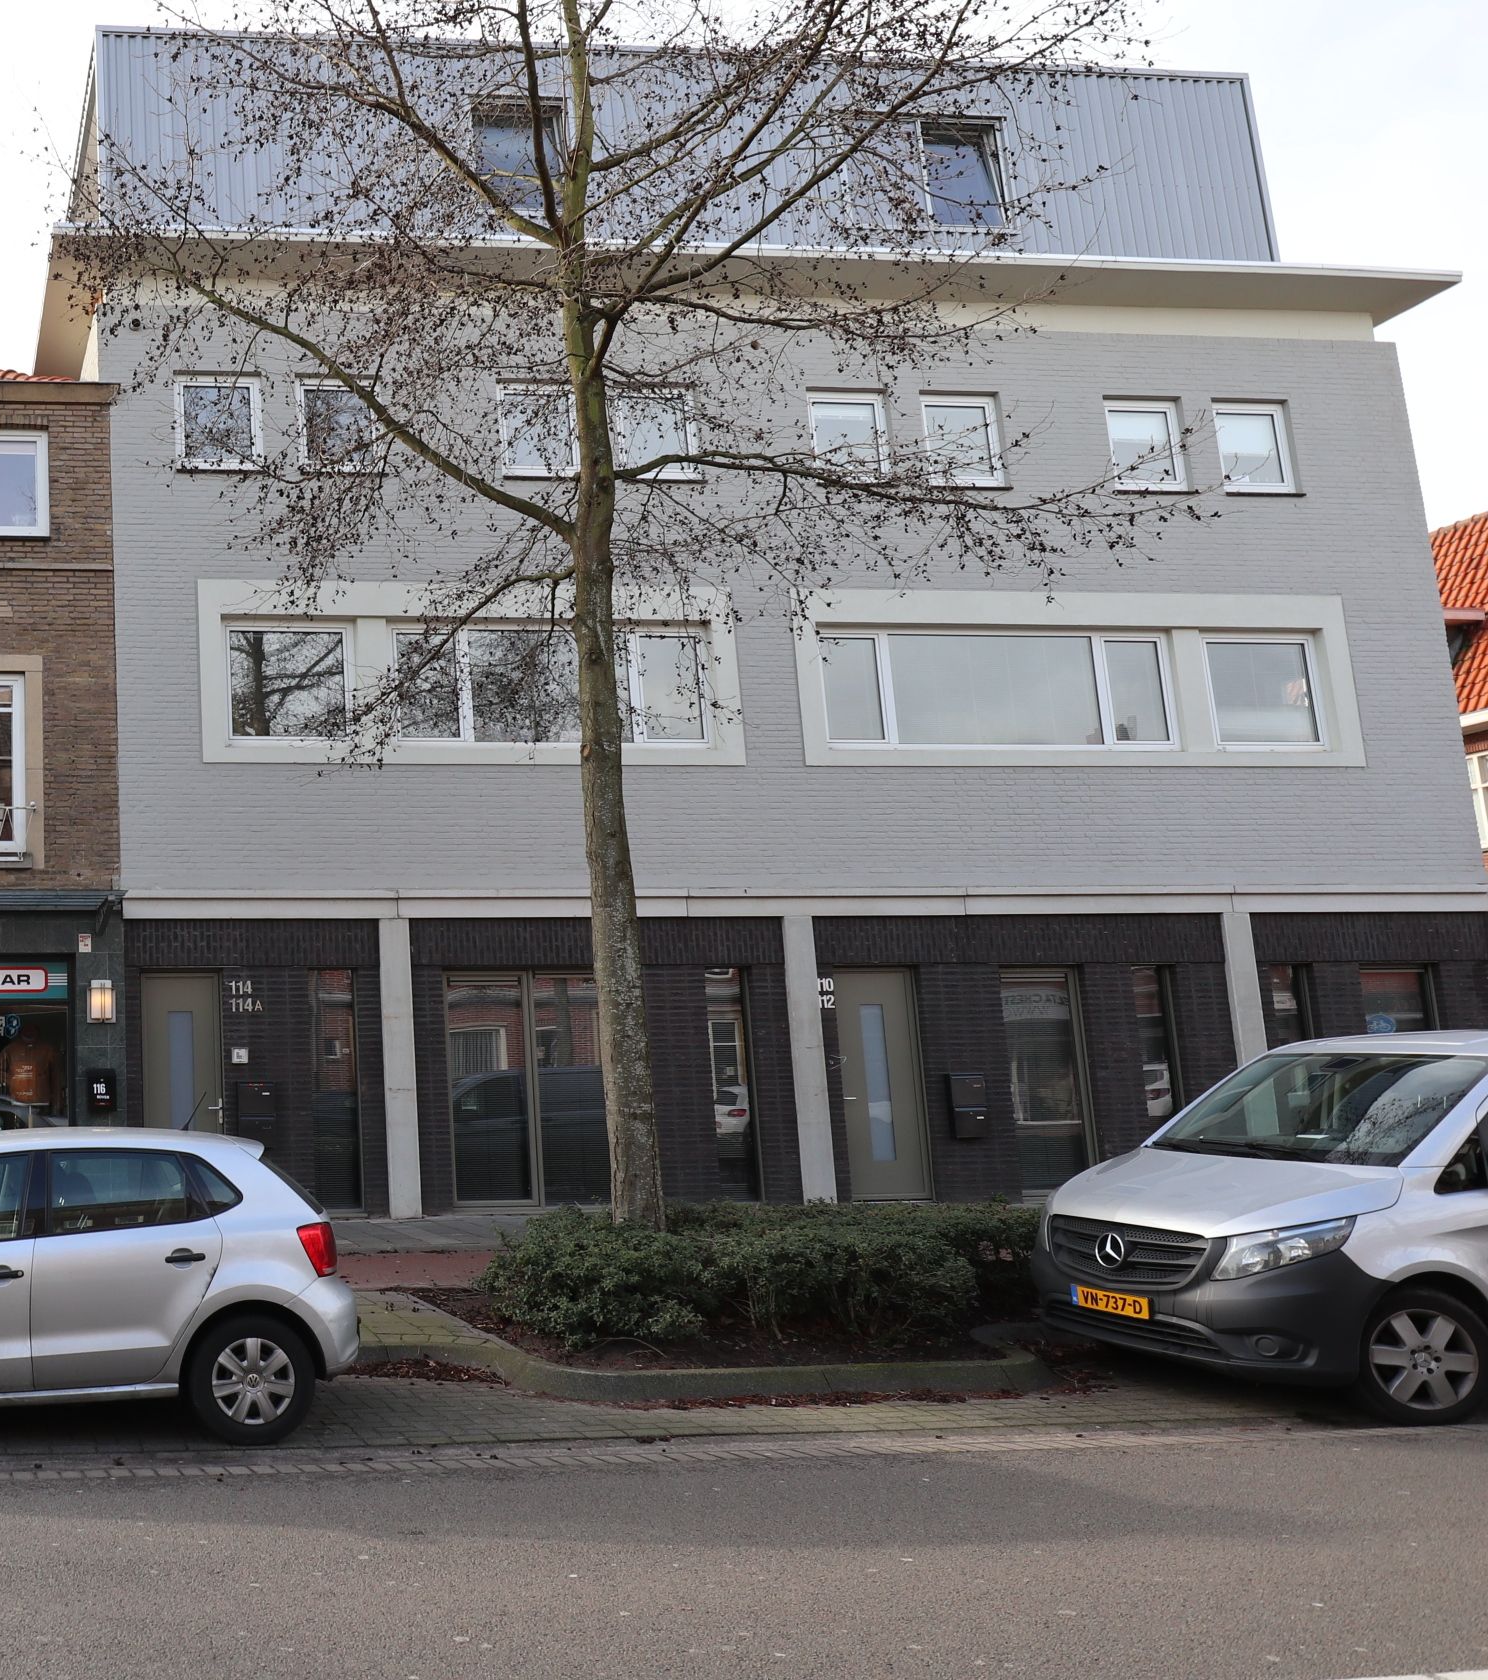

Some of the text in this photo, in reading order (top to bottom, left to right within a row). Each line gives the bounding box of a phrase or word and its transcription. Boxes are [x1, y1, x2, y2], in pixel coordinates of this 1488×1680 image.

[228, 980, 253, 995] 114
[818, 994, 836, 1009] 112
[92, 1083, 106, 1095] 116
[1081, 1289, 1143, 1315] VN-737-D
